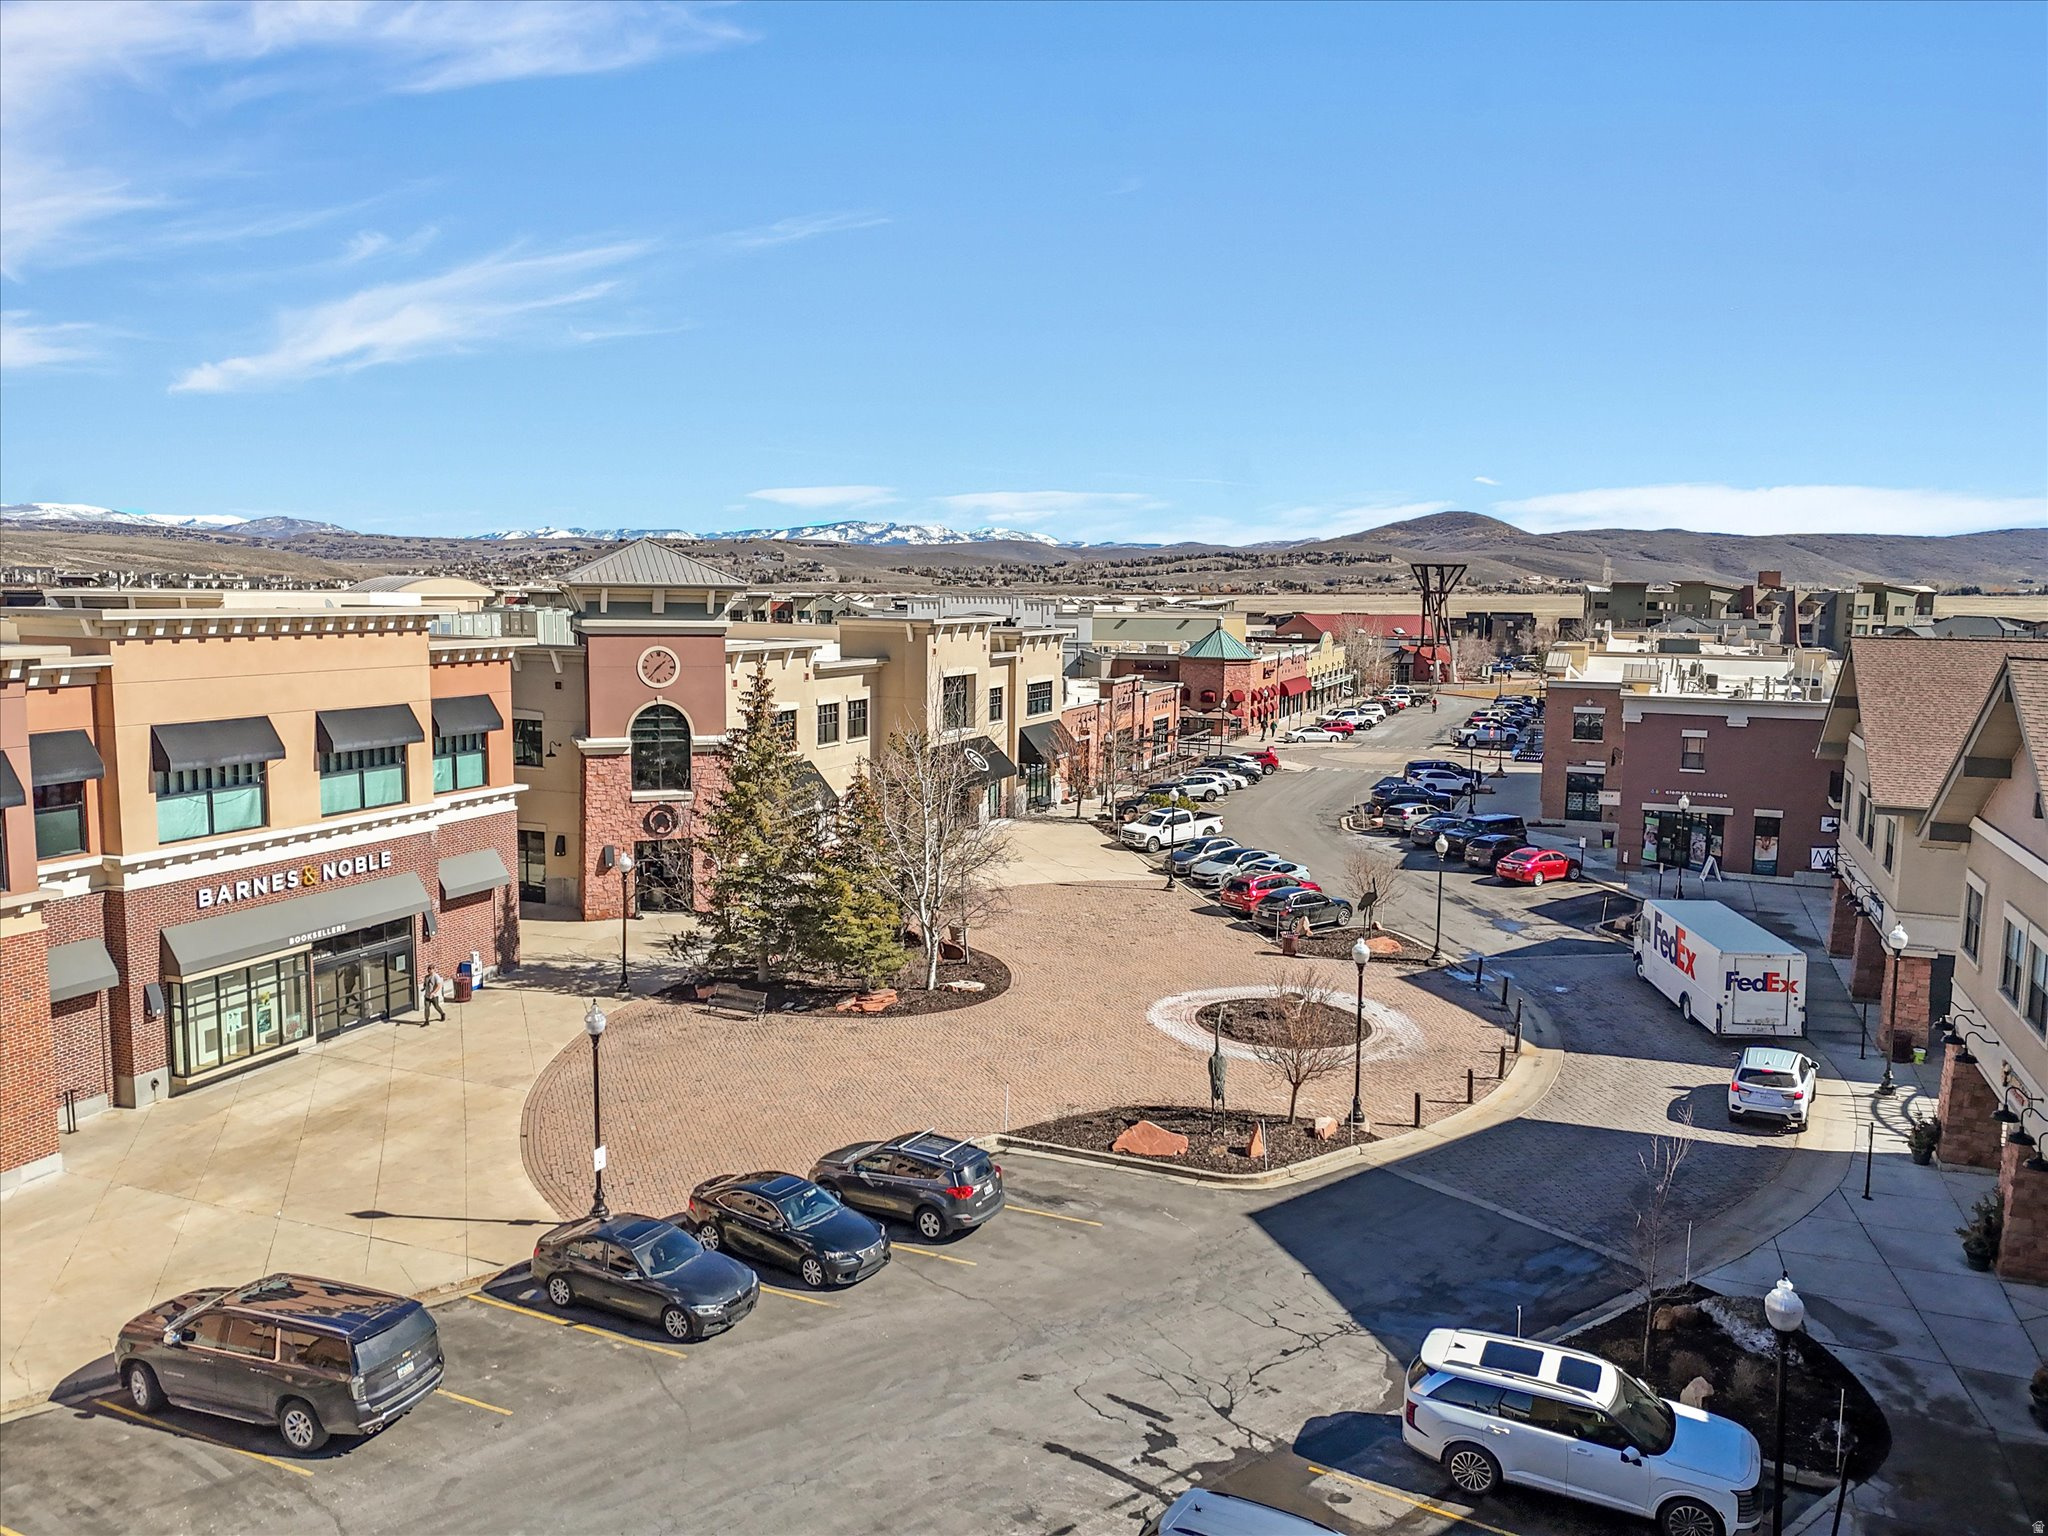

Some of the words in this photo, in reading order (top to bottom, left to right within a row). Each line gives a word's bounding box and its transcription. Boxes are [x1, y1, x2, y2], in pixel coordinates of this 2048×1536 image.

[197, 869, 299, 909] BARNES
[302, 864, 319, 887] &
[321, 850, 392, 882] NOBLE
[288, 923, 347, 946] BOOKSELLERS
[1653, 910, 1697, 981] FedEx
[1725, 971, 1799, 994] FedEx
